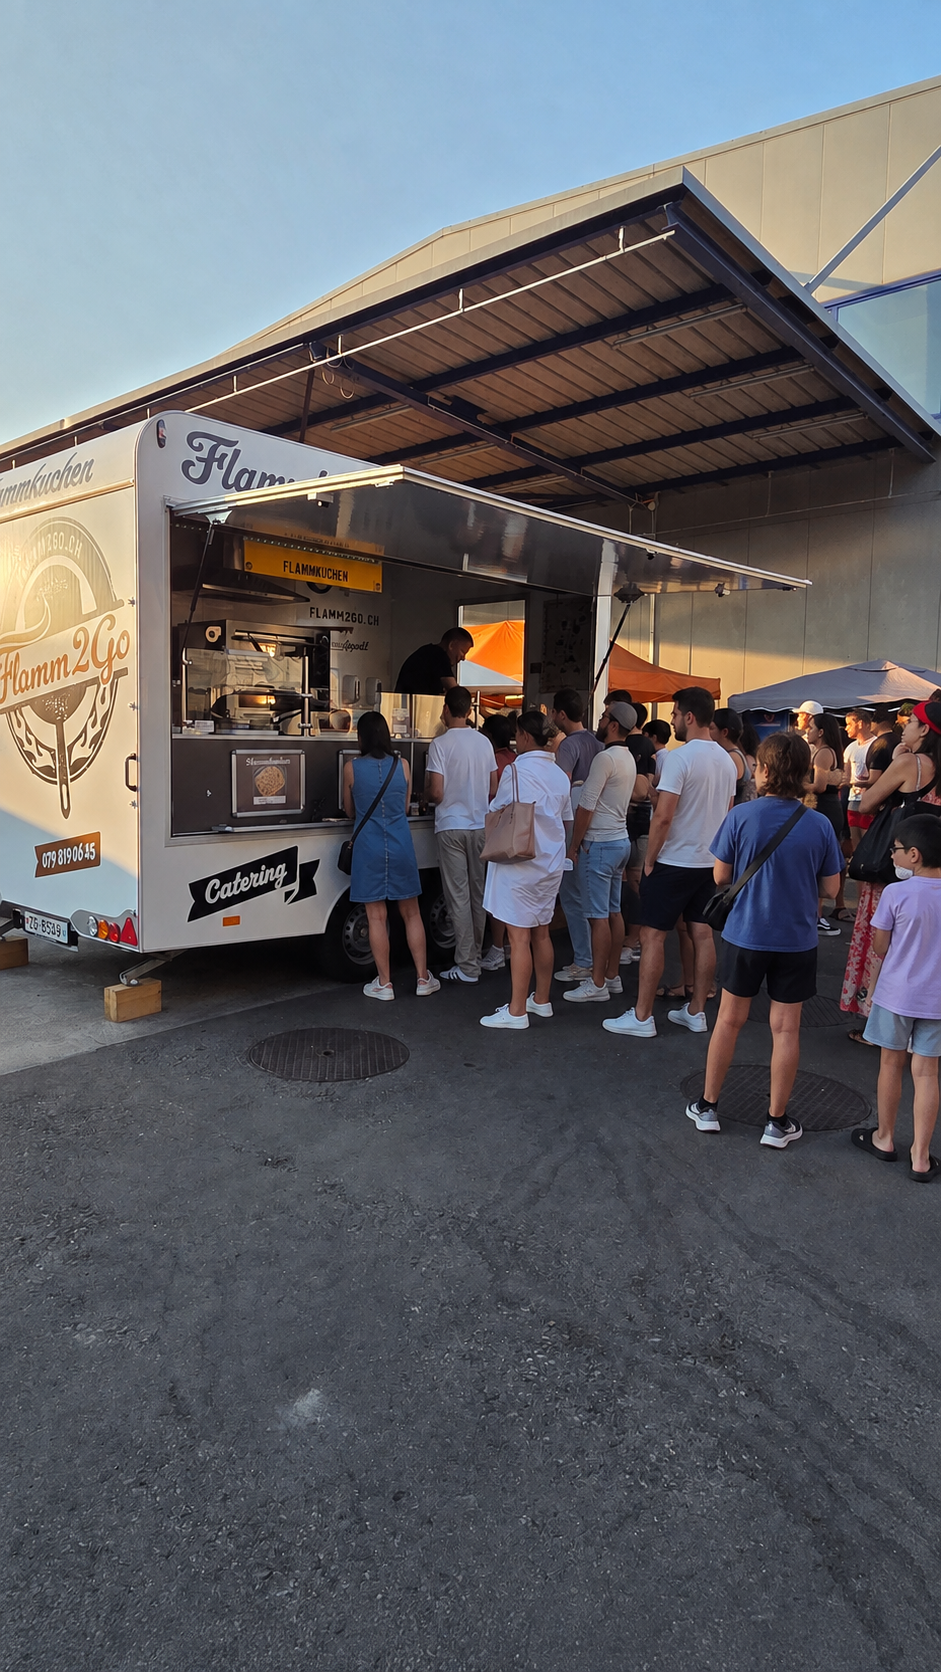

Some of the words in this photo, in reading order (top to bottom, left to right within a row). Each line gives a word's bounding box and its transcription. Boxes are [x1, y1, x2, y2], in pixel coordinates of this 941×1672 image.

[283, 560, 349, 582] FLAMMKUCHEN
[309, 606, 379, 626] FLAMM2GO.CH
[42, 851, 57, 869] 079
[58, 847, 72, 865] 819
[73, 842, 84, 862] 06
[205, 862, 288, 904] Catering
